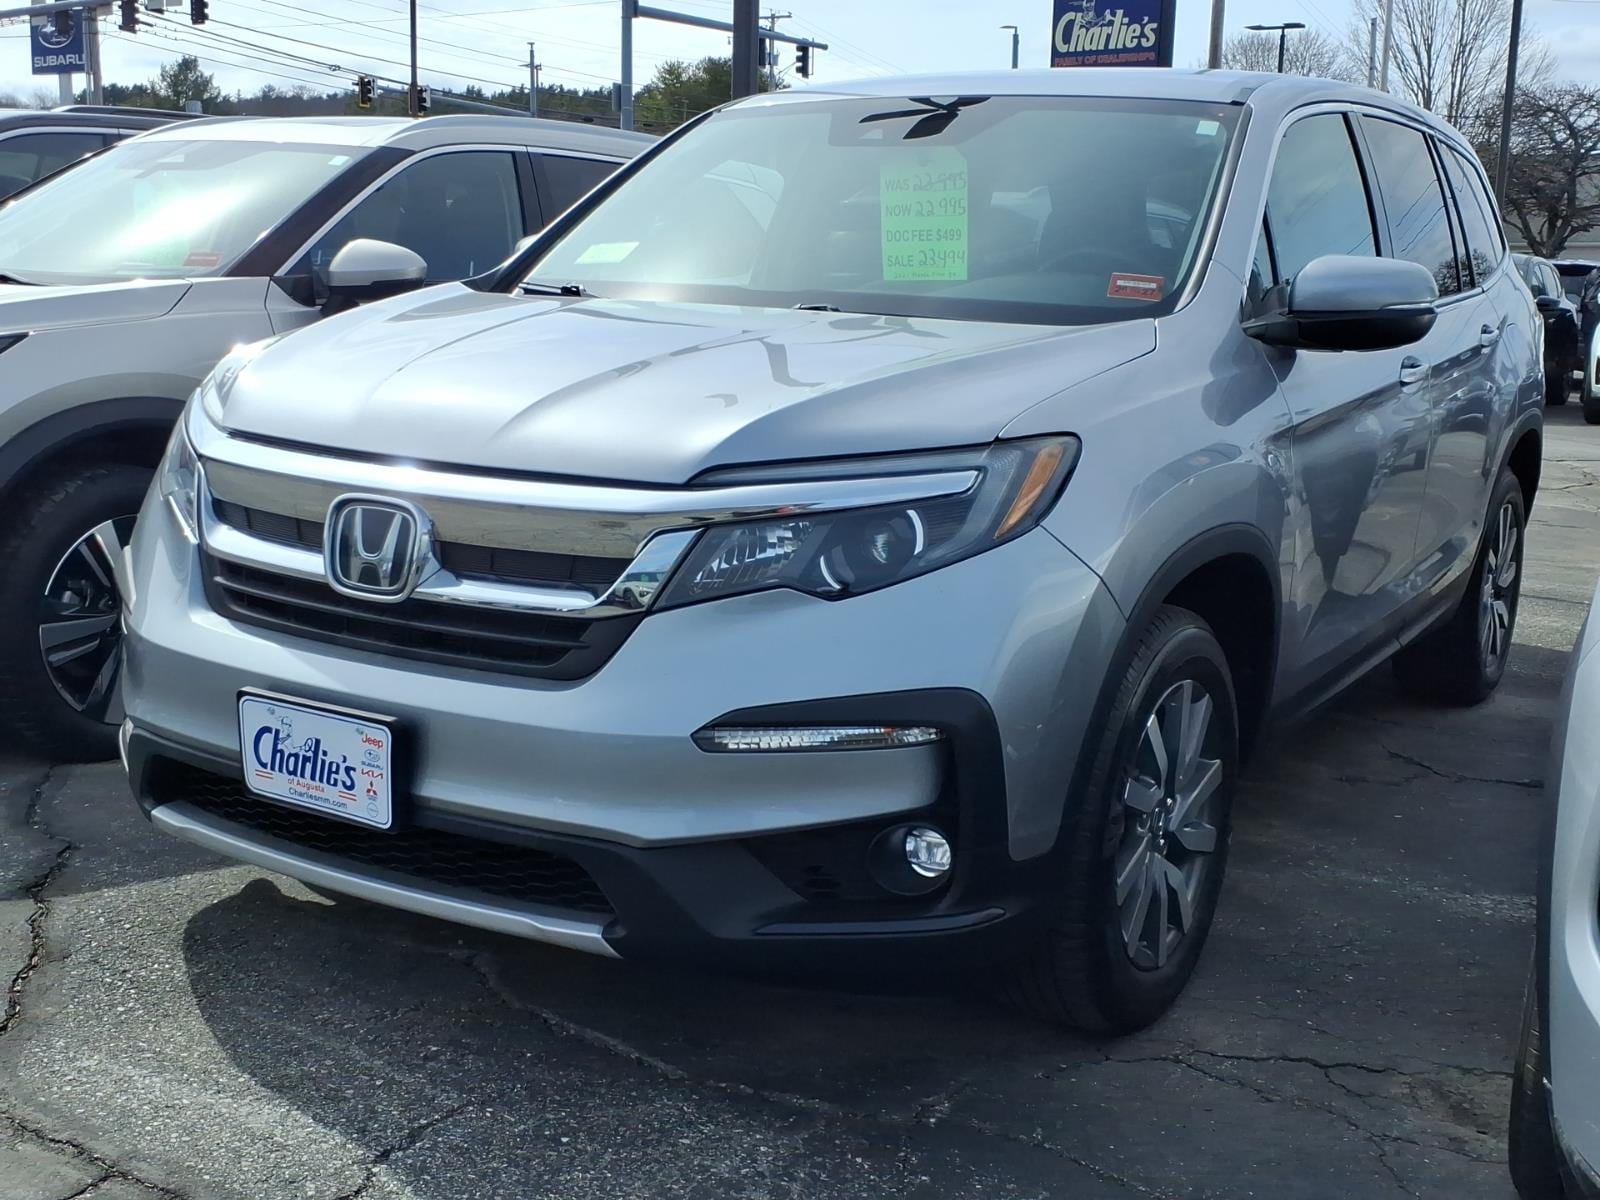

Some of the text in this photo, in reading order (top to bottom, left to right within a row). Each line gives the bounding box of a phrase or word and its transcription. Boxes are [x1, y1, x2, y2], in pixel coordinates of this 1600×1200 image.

[1055, 9, 1158, 52] Charlie's
[34, 54, 87, 67] SUBARU
[884, 178, 910, 192] WAS
[886, 203, 912, 216] NOW
[886, 230, 909, 242] DOC
[911, 229, 933, 241] FEE
[887, 255, 914, 267] SALE
[361, 733, 384, 749] Jeep
[253, 725, 356, 792] Charlie's
[287, 778, 325, 793] of Augusta
[288, 787, 348, 809] Charliesmm.com
